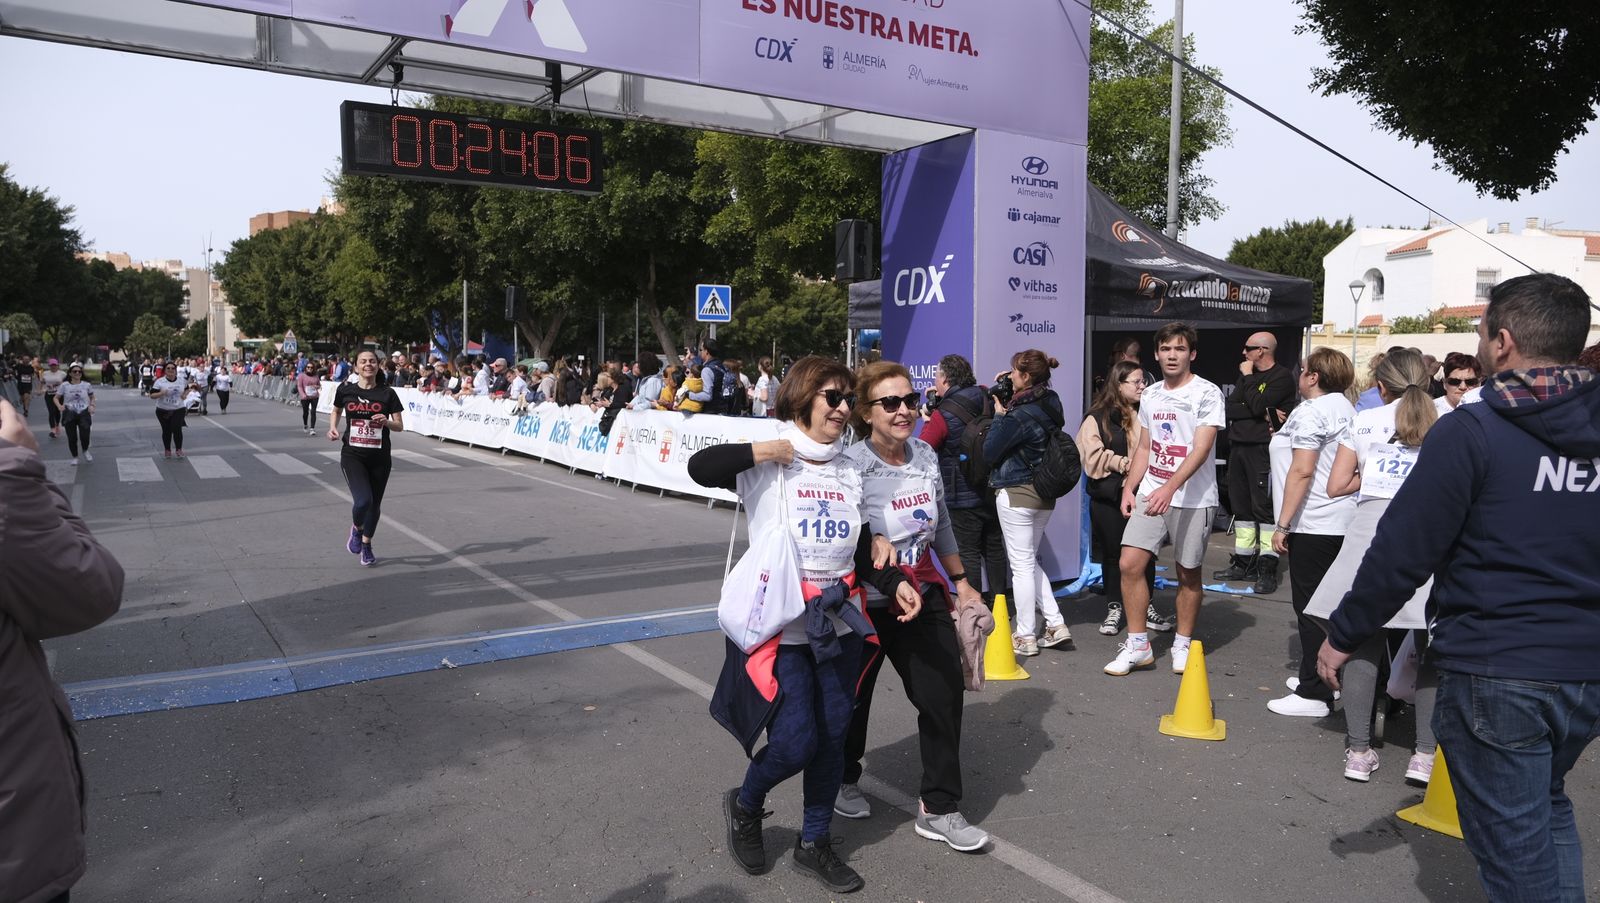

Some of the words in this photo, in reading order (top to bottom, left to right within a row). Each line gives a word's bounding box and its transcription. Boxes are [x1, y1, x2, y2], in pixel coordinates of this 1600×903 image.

[784, 0, 903, 42] NUESTRA
[908, 21, 979, 57] META.
[755, 37, 798, 63] CDX
[843, 51, 887, 70] ALMERÍA
[843, 63, 866, 74] CIUDAD
[391, 114, 591, 184] 00:24:06
[1011, 175, 1059, 190] HYUNDAI
[1023, 211, 1061, 225] cajamar
[894, 254, 954, 307] CDX
[1023, 280, 1058, 293] vithas
[1015, 320, 1056, 336] aqualia
[909, 364, 937, 379] ALME
[347, 402, 382, 412] GALO
[1152, 413, 1177, 421] MUJER
[357, 427, 375, 436] 835
[1154, 453, 1176, 467] 734
[1376, 458, 1414, 476] 127
[891, 492, 931, 511] MUJER
[797, 518, 850, 539] 1189
